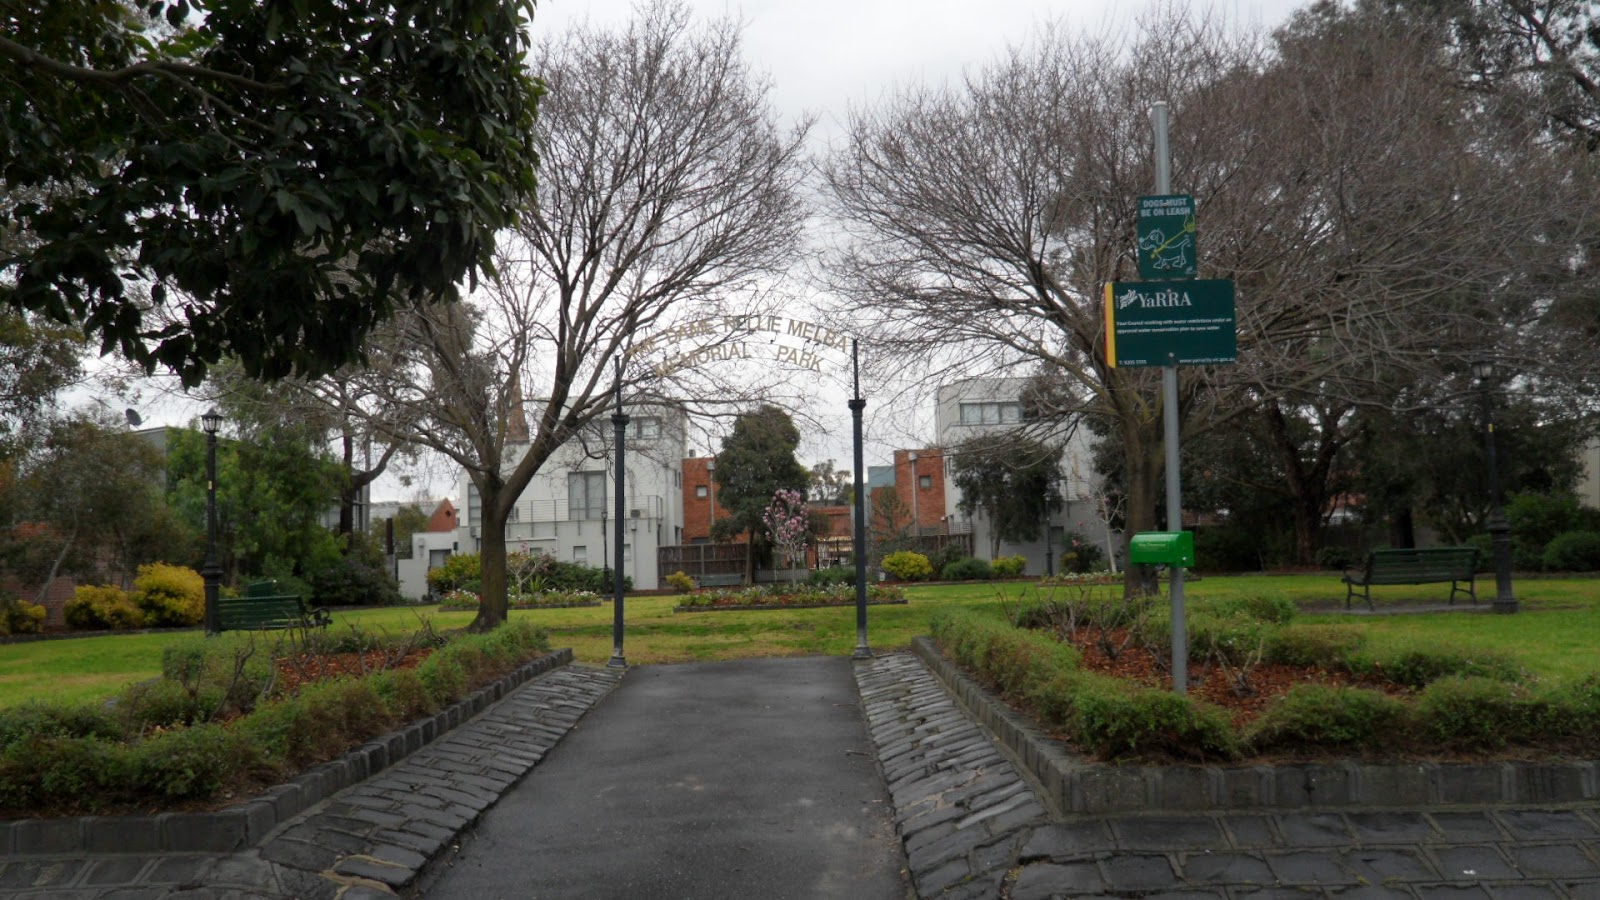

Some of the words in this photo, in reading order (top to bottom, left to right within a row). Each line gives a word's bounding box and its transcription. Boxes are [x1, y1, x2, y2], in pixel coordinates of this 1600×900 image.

[1143, 199, 1164, 208] DOGS
[1165, 197, 1187, 207] MUST
[1140, 208, 1152, 218] BE
[1153, 207, 1165, 217] ON
[1166, 206, 1191, 217] LEASH
[1137, 290, 1193, 308] YaRRA
[664, 321, 716, 344] DAME
[723, 315, 782, 333] NELLIE
[787, 318, 848, 352] MELBA
[652, 341, 752, 377] MEMORIAL
[775, 344, 824, 372] PARK
